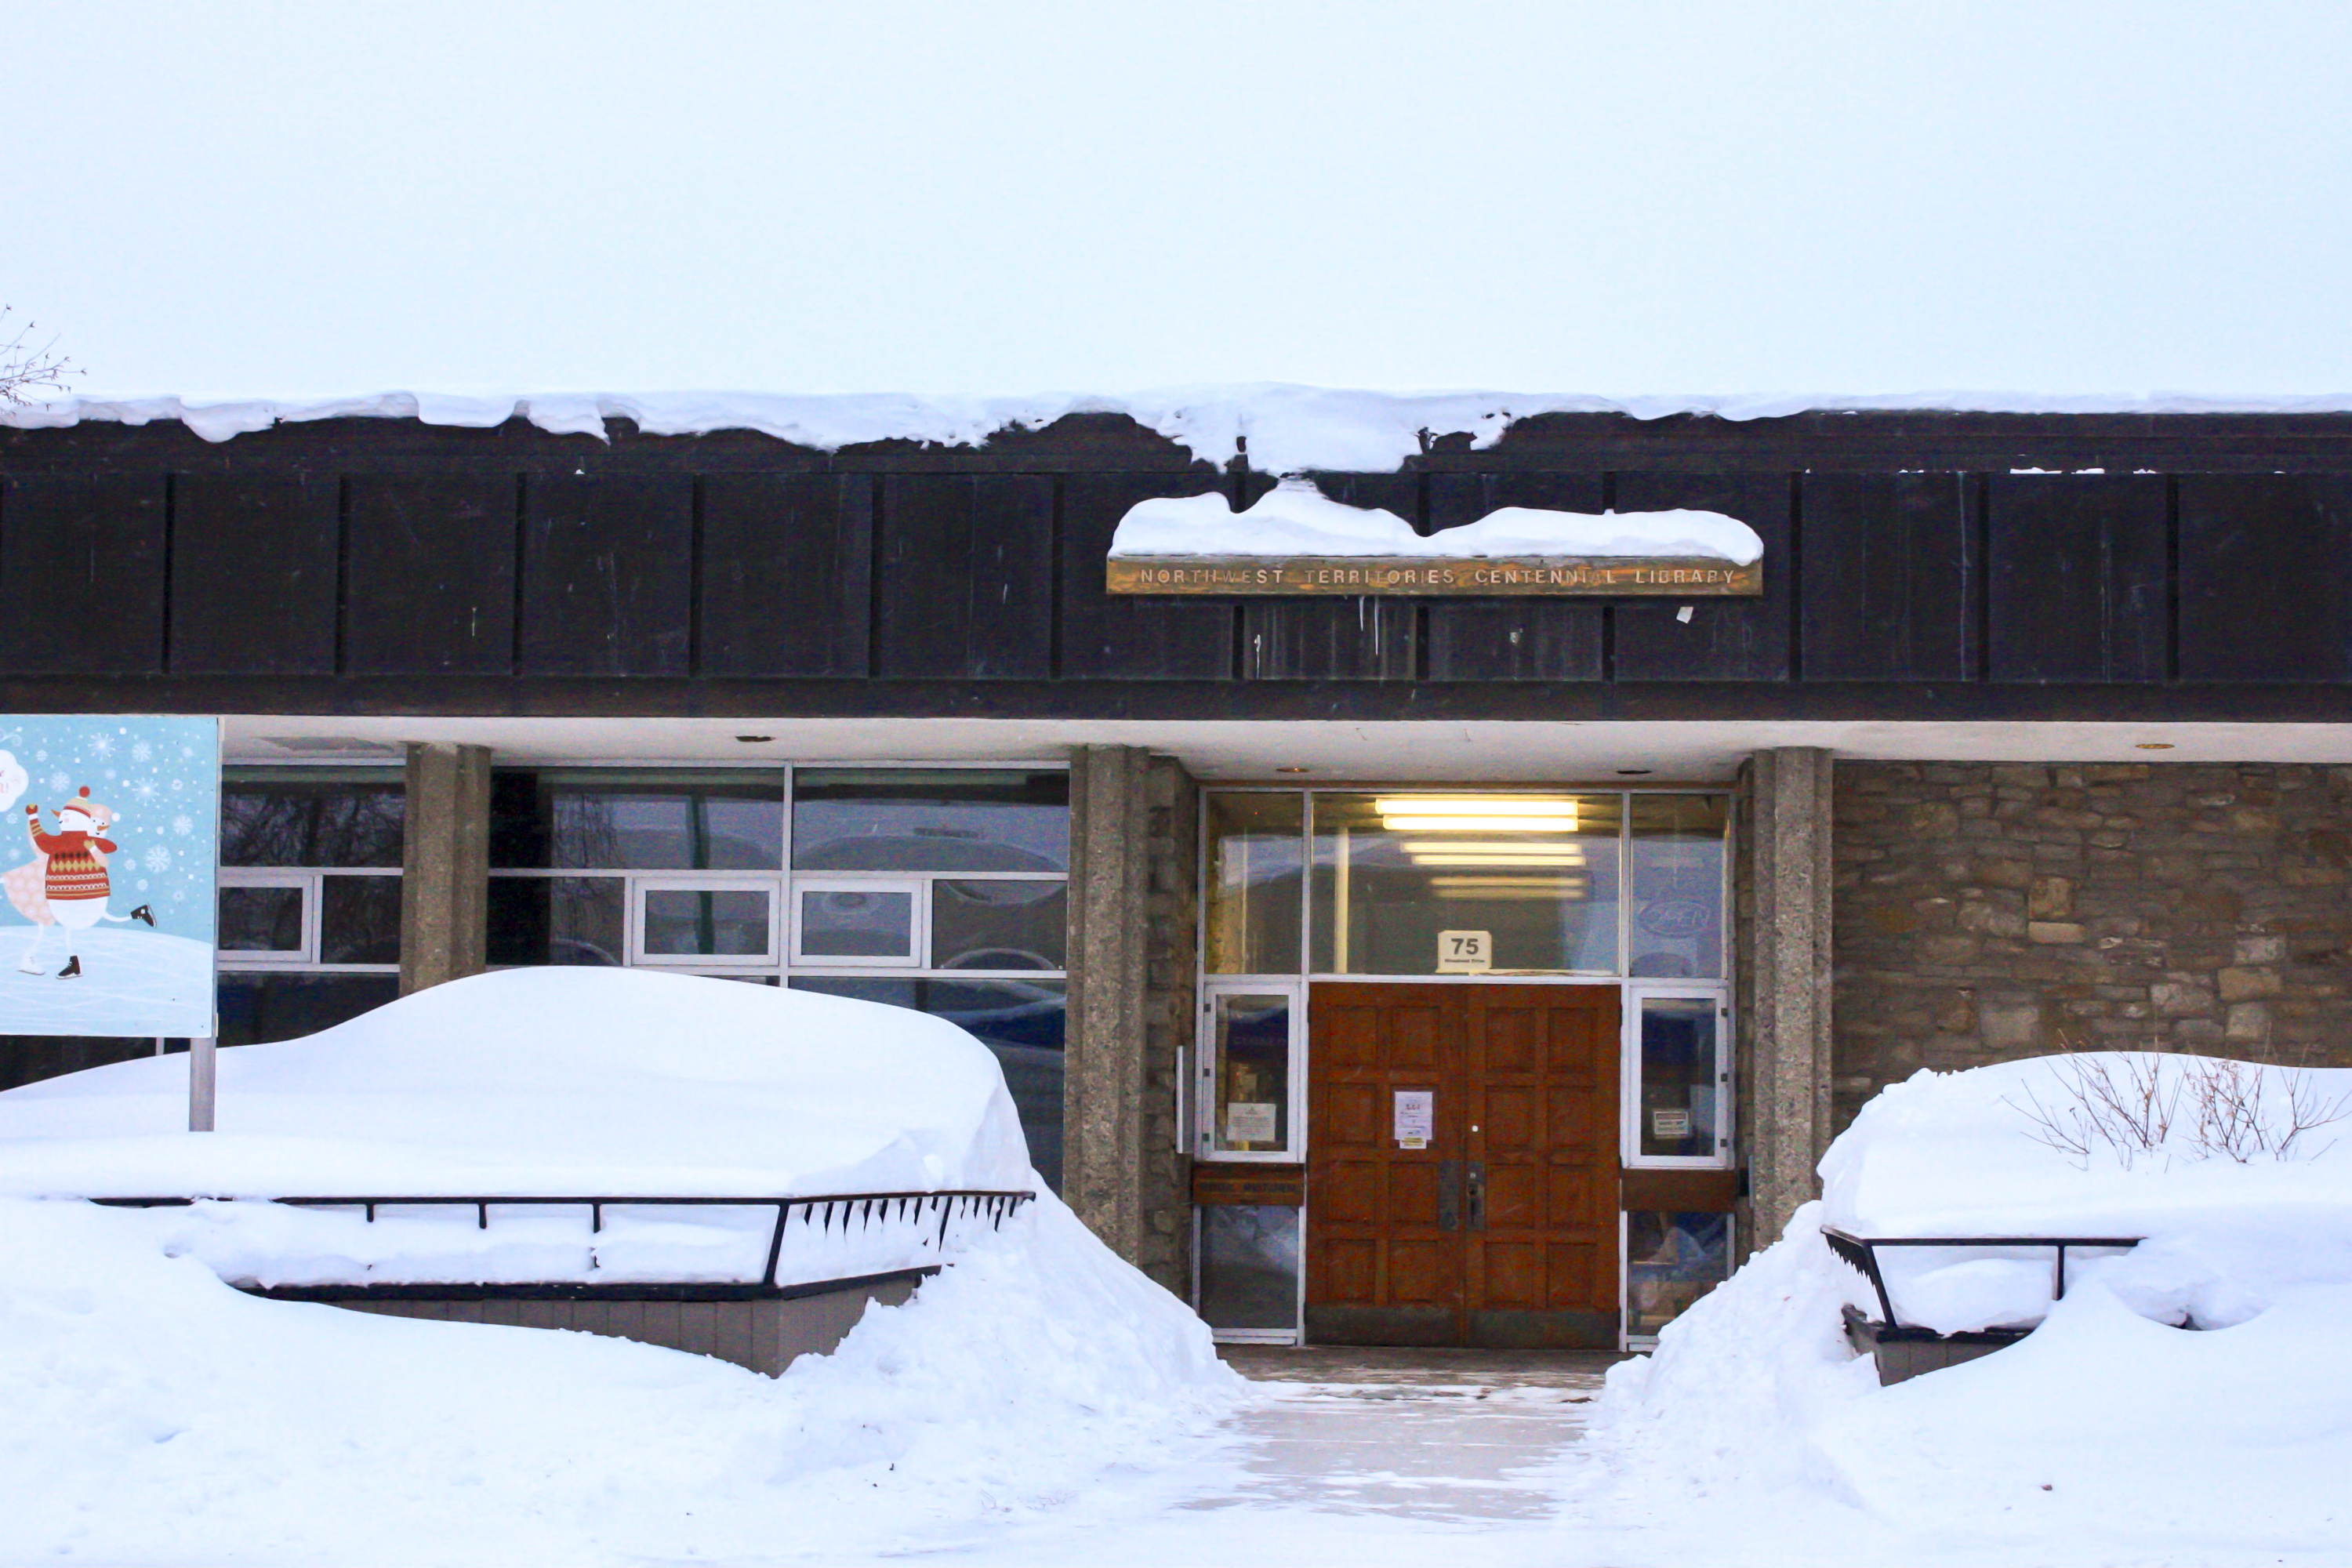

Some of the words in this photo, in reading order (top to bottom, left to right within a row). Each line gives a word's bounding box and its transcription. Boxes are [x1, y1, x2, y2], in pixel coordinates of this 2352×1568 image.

[1141, 569, 1283, 584] NORTHWEST
[1305, 569, 1454, 584] TERRITORIES
[1475, 569, 1617, 584] CENTENNIAL
[1635, 569, 1734, 584] LIBRARY
[1450, 938, 1479, 955] 75
